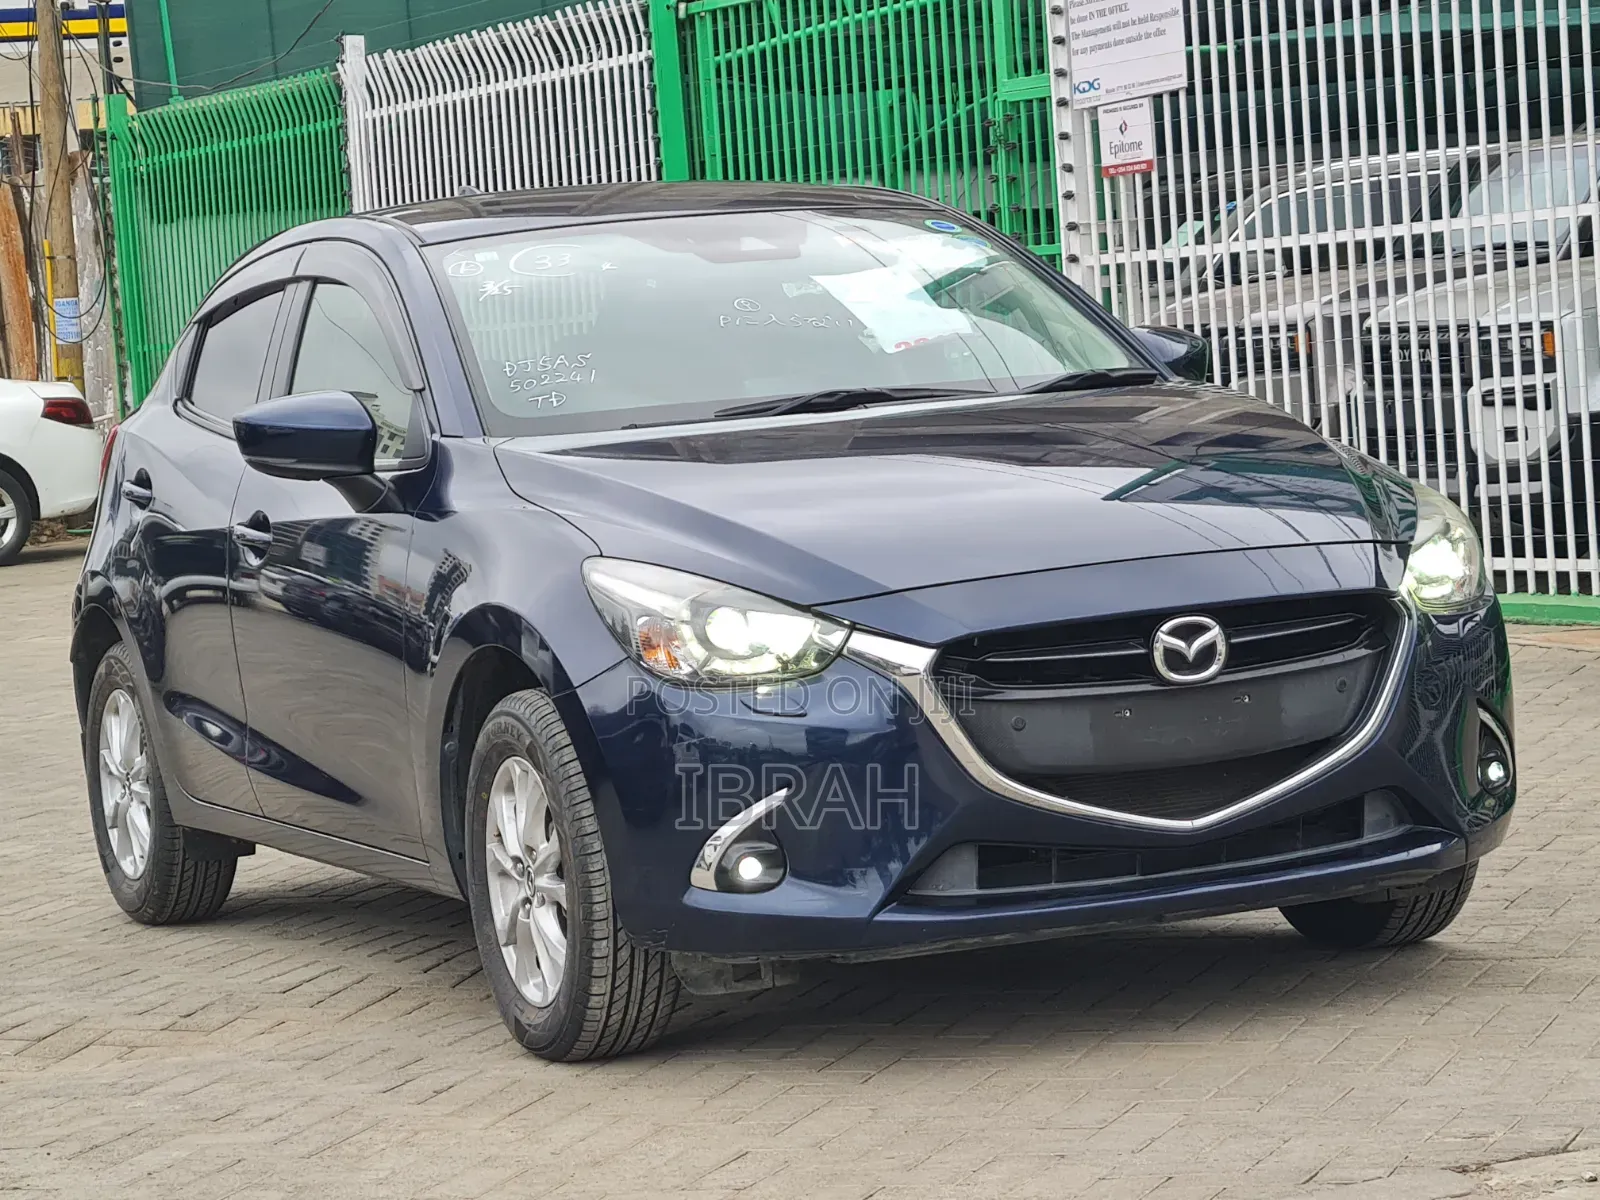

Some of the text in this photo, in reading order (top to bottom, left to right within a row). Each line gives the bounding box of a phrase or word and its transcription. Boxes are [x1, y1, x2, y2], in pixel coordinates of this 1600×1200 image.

[1096, 8, 1107, 18] THE
[1150, 7, 1180, 22] Responsible
[1089, 40, 1112, 55] payments
[1153, 27, 1166, 37] office
[1109, 139, 1143, 159] Epitome
[534, 253, 572, 270] 33
[510, 369, 596, 393] 502241
